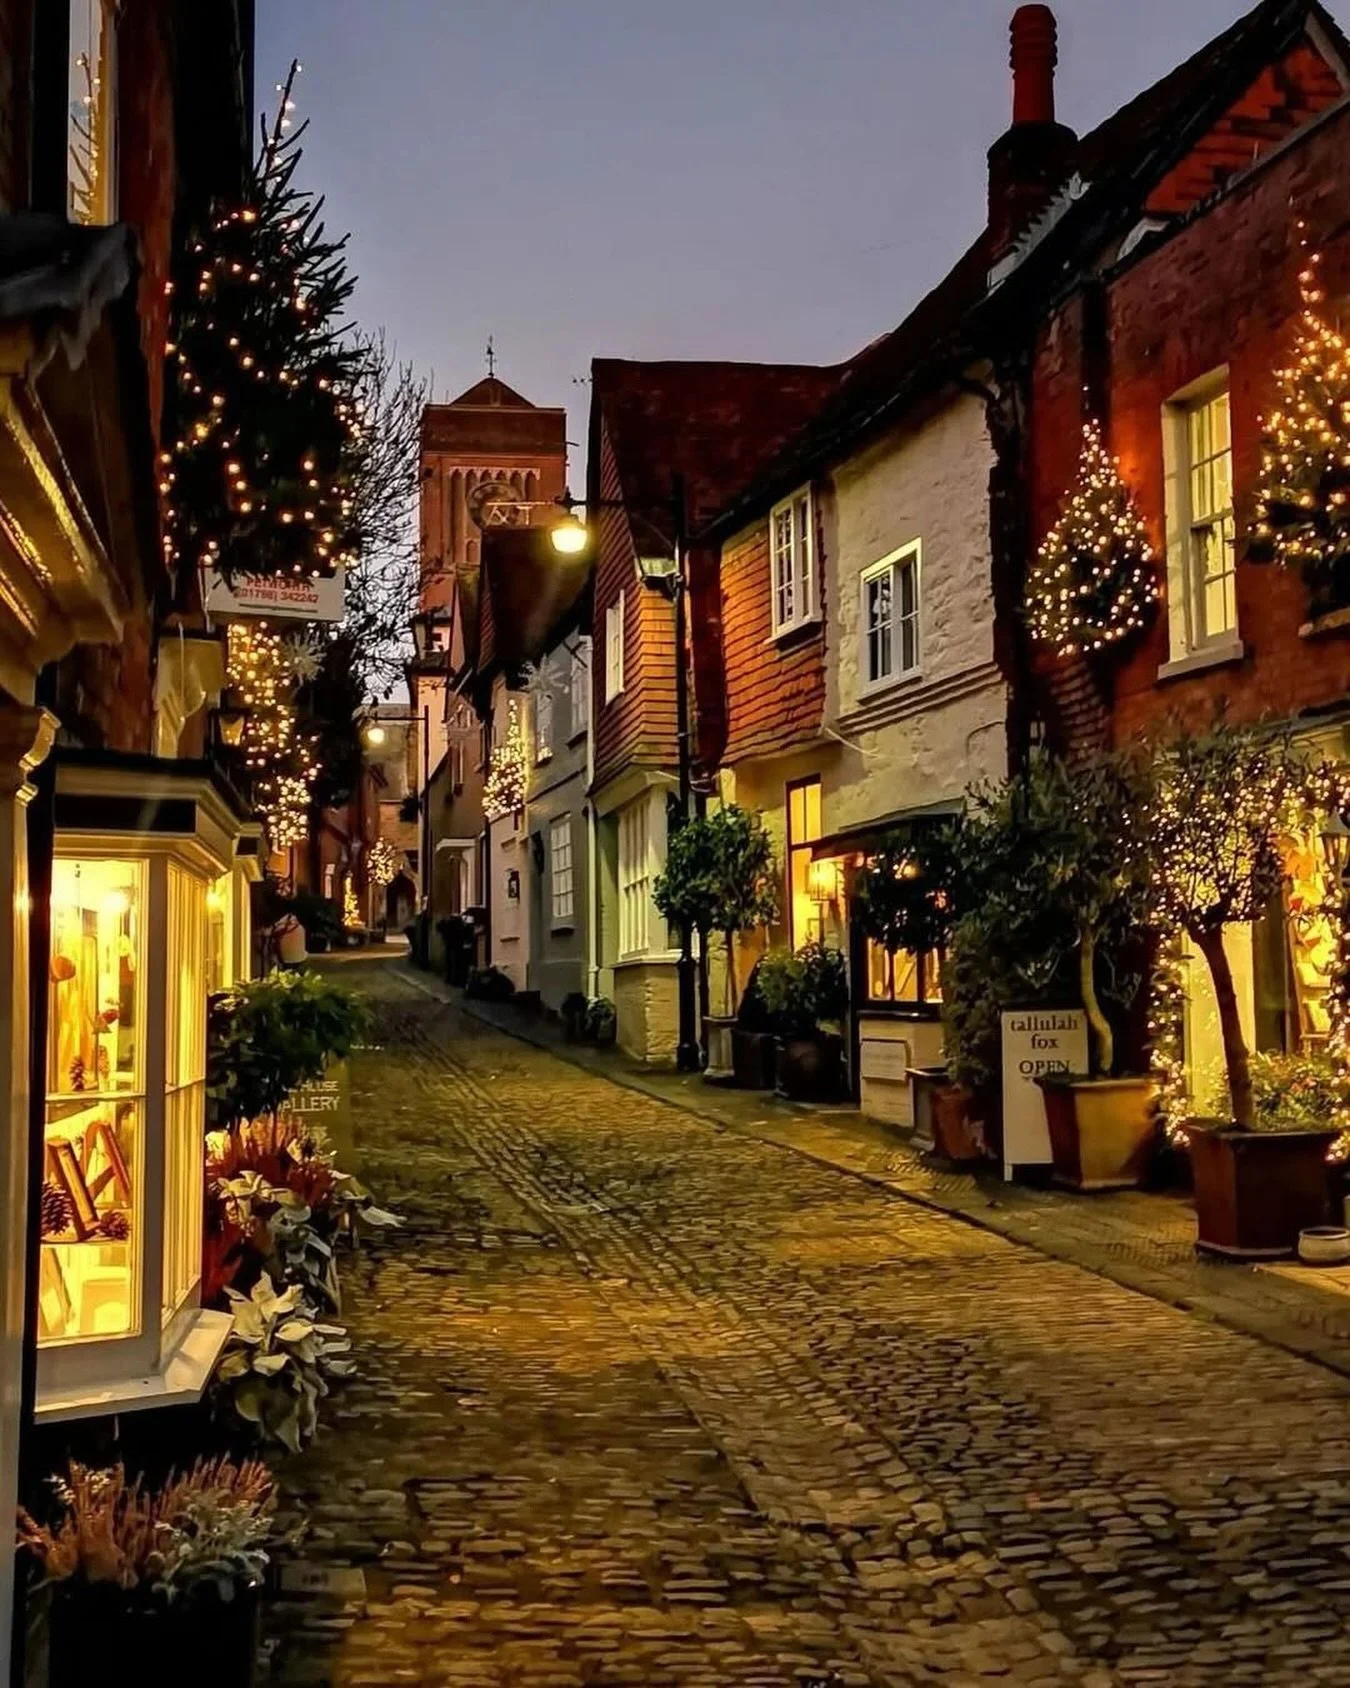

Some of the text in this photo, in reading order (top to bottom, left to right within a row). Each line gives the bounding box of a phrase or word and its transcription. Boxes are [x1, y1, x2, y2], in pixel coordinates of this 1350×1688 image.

[1010, 1014, 1078, 1031] tallulah
[1031, 1033, 1060, 1050] fox
[1019, 1060, 1070, 1075] OPEN
